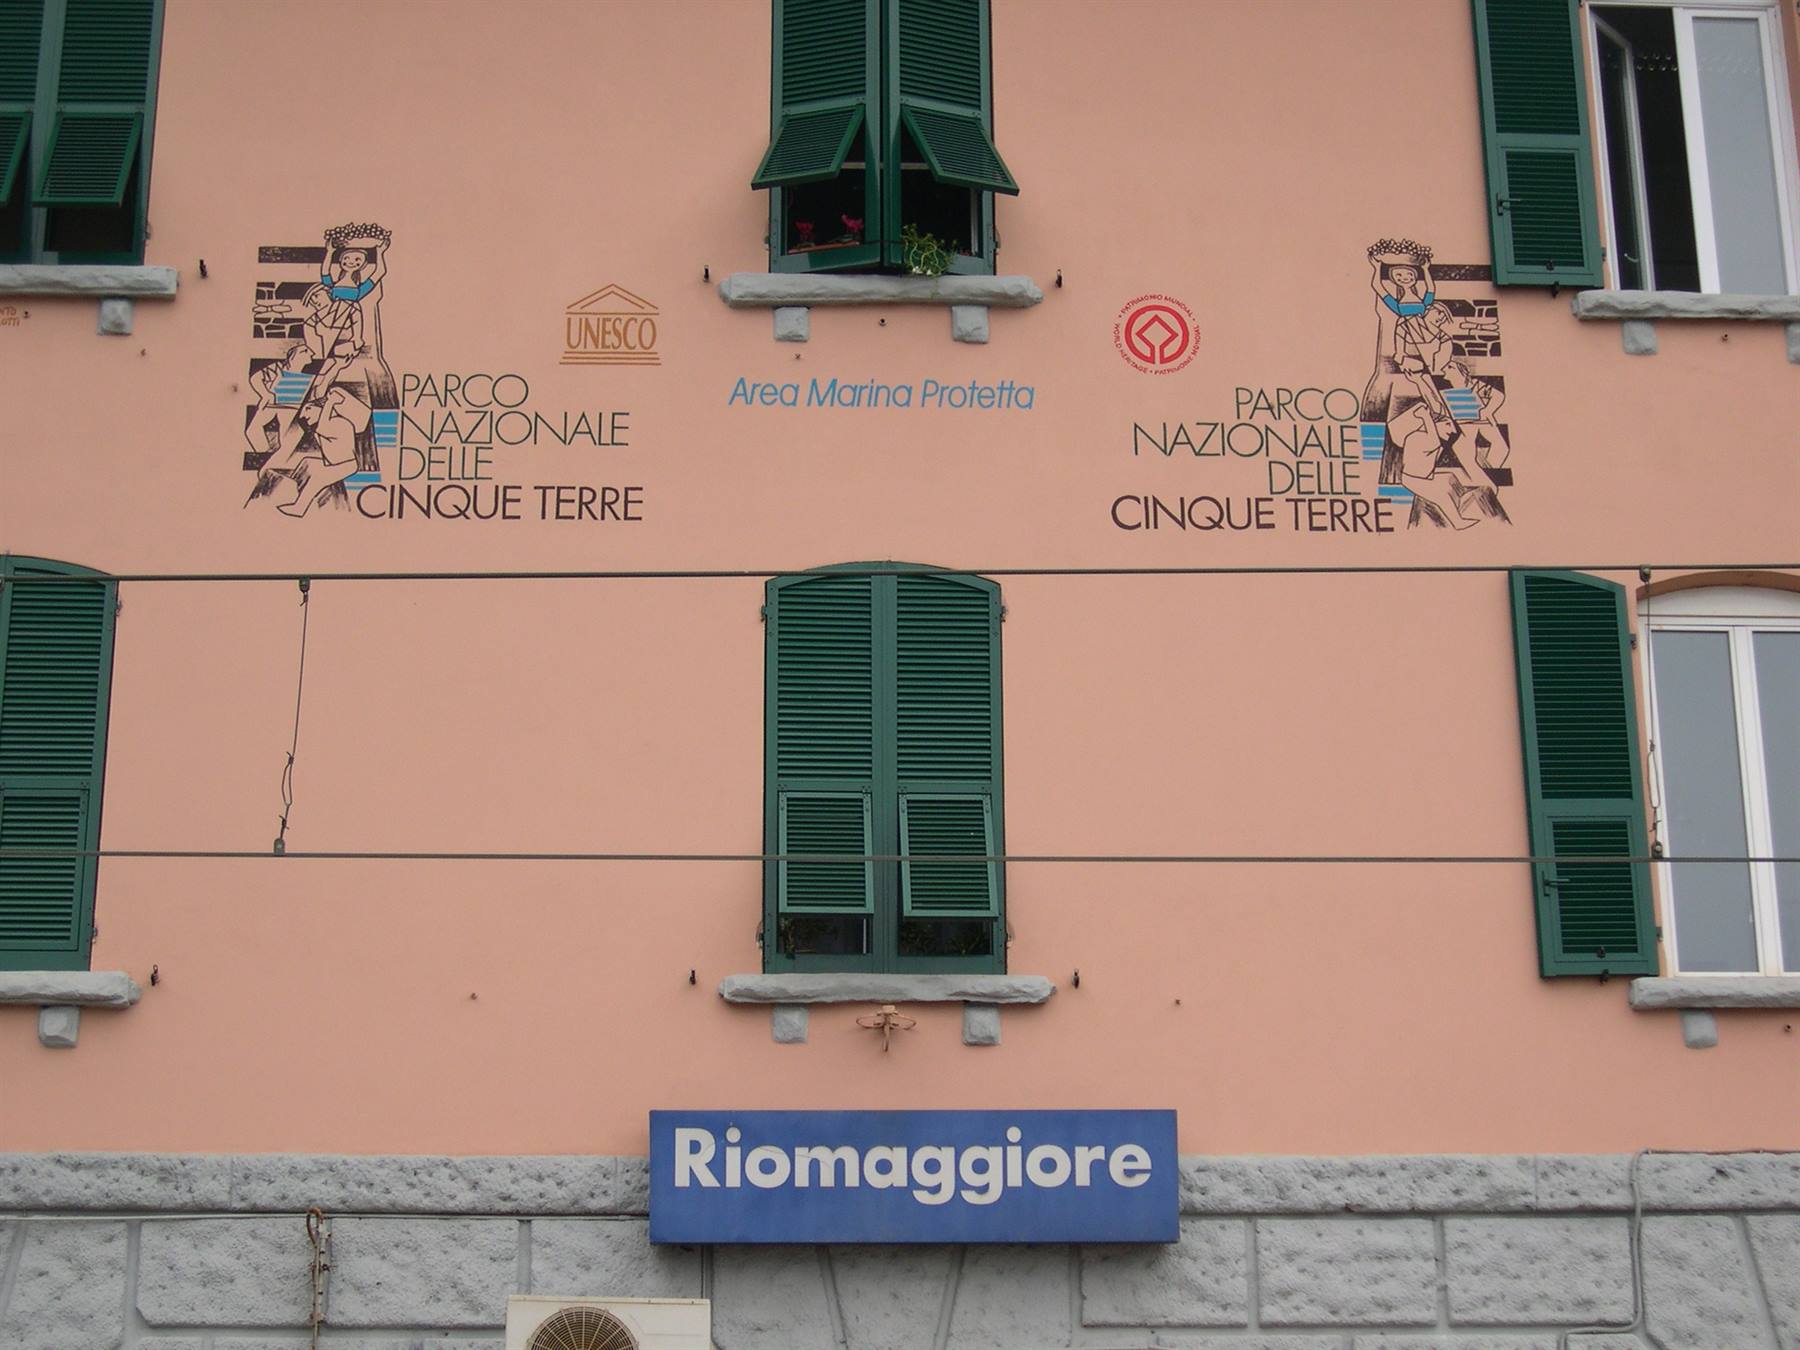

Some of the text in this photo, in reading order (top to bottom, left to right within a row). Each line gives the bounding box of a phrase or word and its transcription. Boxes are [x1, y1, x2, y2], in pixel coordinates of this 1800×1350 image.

[1164, 295, 1193, 318] MUNDIAL
[566, 316, 657, 351] UNESCO
[1112, 323, 1123, 349] WORLD
[401, 374, 529, 408] PARCO
[728, 377, 1035, 410] Area Marina Protetta
[1235, 387, 1360, 422] PARCO
[400, 410, 630, 446] NAZIONALE
[1133, 422, 1360, 459] NAZIONALE
[399, 446, 494, 481] DELLE
[1268, 460, 1362, 496] DELLE
[356, 484, 644, 521] CINQUE TERRE
[1110, 495, 1395, 533] CINQUE TERRE
[674, 1126, 1153, 1205] Riomaggiore
